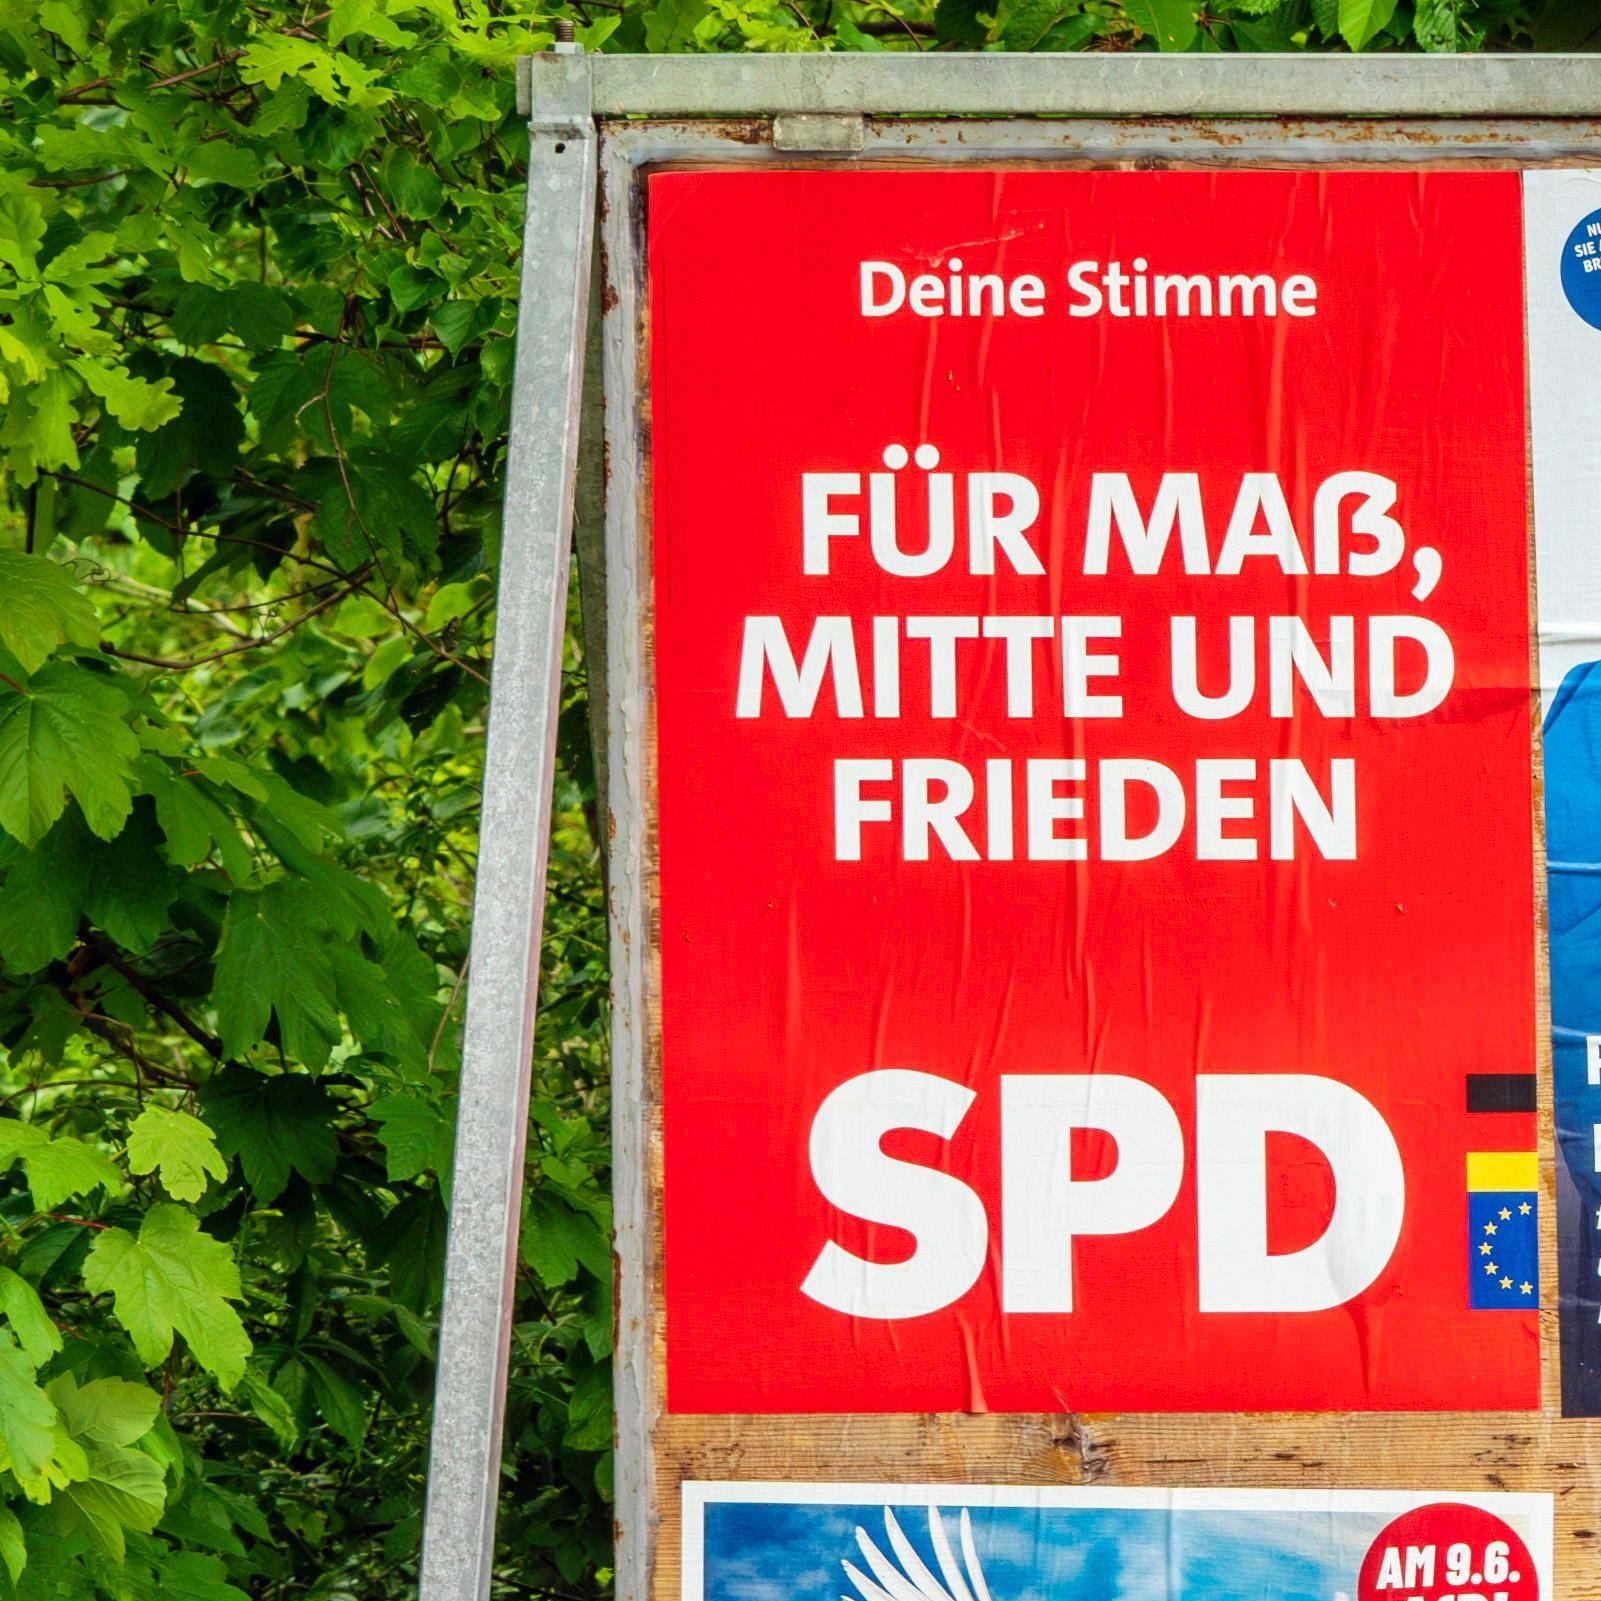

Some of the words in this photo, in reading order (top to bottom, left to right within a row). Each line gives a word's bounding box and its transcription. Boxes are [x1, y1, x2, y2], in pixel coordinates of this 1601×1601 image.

[860, 259, 1045, 318] Deine
[1068, 259, 1318, 318] Stimme
[1574, 242, 1596, 257] SIE
[802, 443, 1046, 577] FÜR
[736, 615, 1123, 719] MITTE
[1170, 615, 1454, 719] UND
[833, 757, 1357, 862] FRIEDEN
[800, 1068, 1406, 1319] SPD
[1376, 1546, 1435, 1589] AM
[1446, 1540, 1520, 1587] 9.6.
